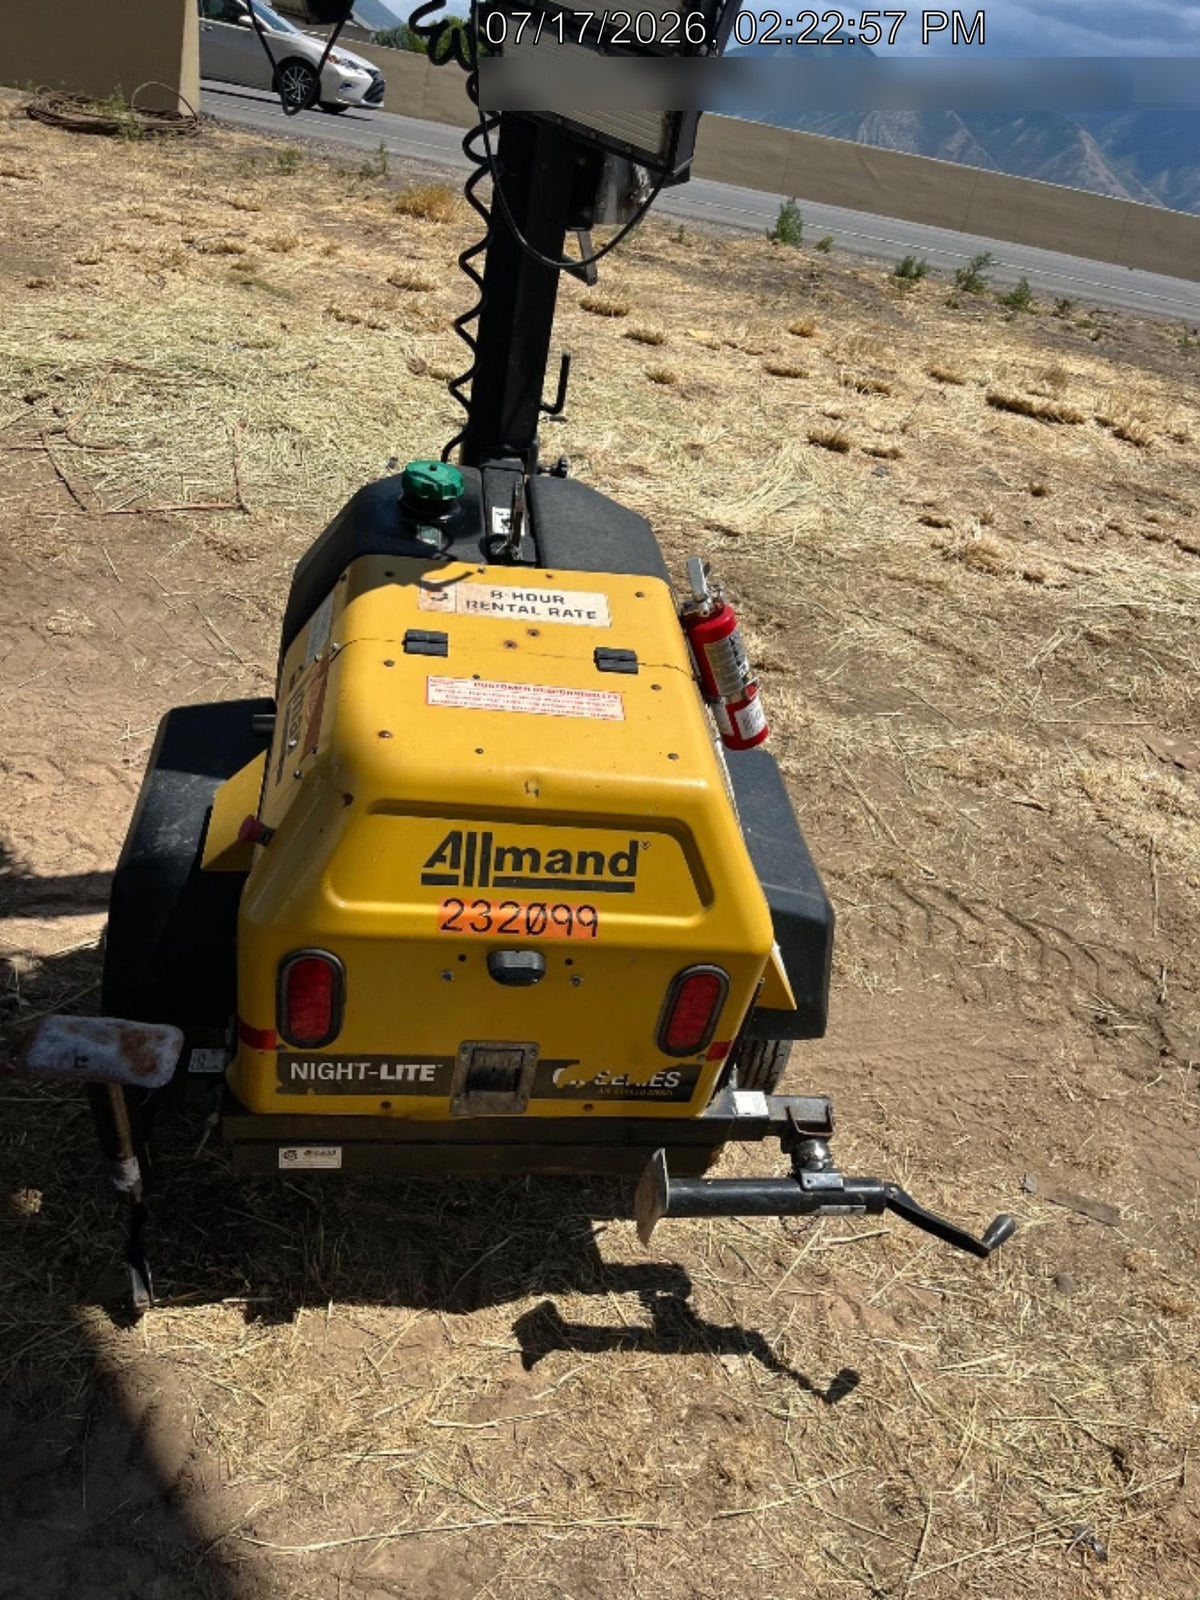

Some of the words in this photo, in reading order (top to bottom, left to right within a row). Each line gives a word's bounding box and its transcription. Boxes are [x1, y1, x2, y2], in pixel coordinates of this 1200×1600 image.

[465, 600, 541, 616] RENTAL
[548, 607, 597, 620] RATE
[422, 830, 639, 888] Allmand
[440, 897, 599, 937] 232099
[290, 1062, 436, 1082] NIGHT-LITE
